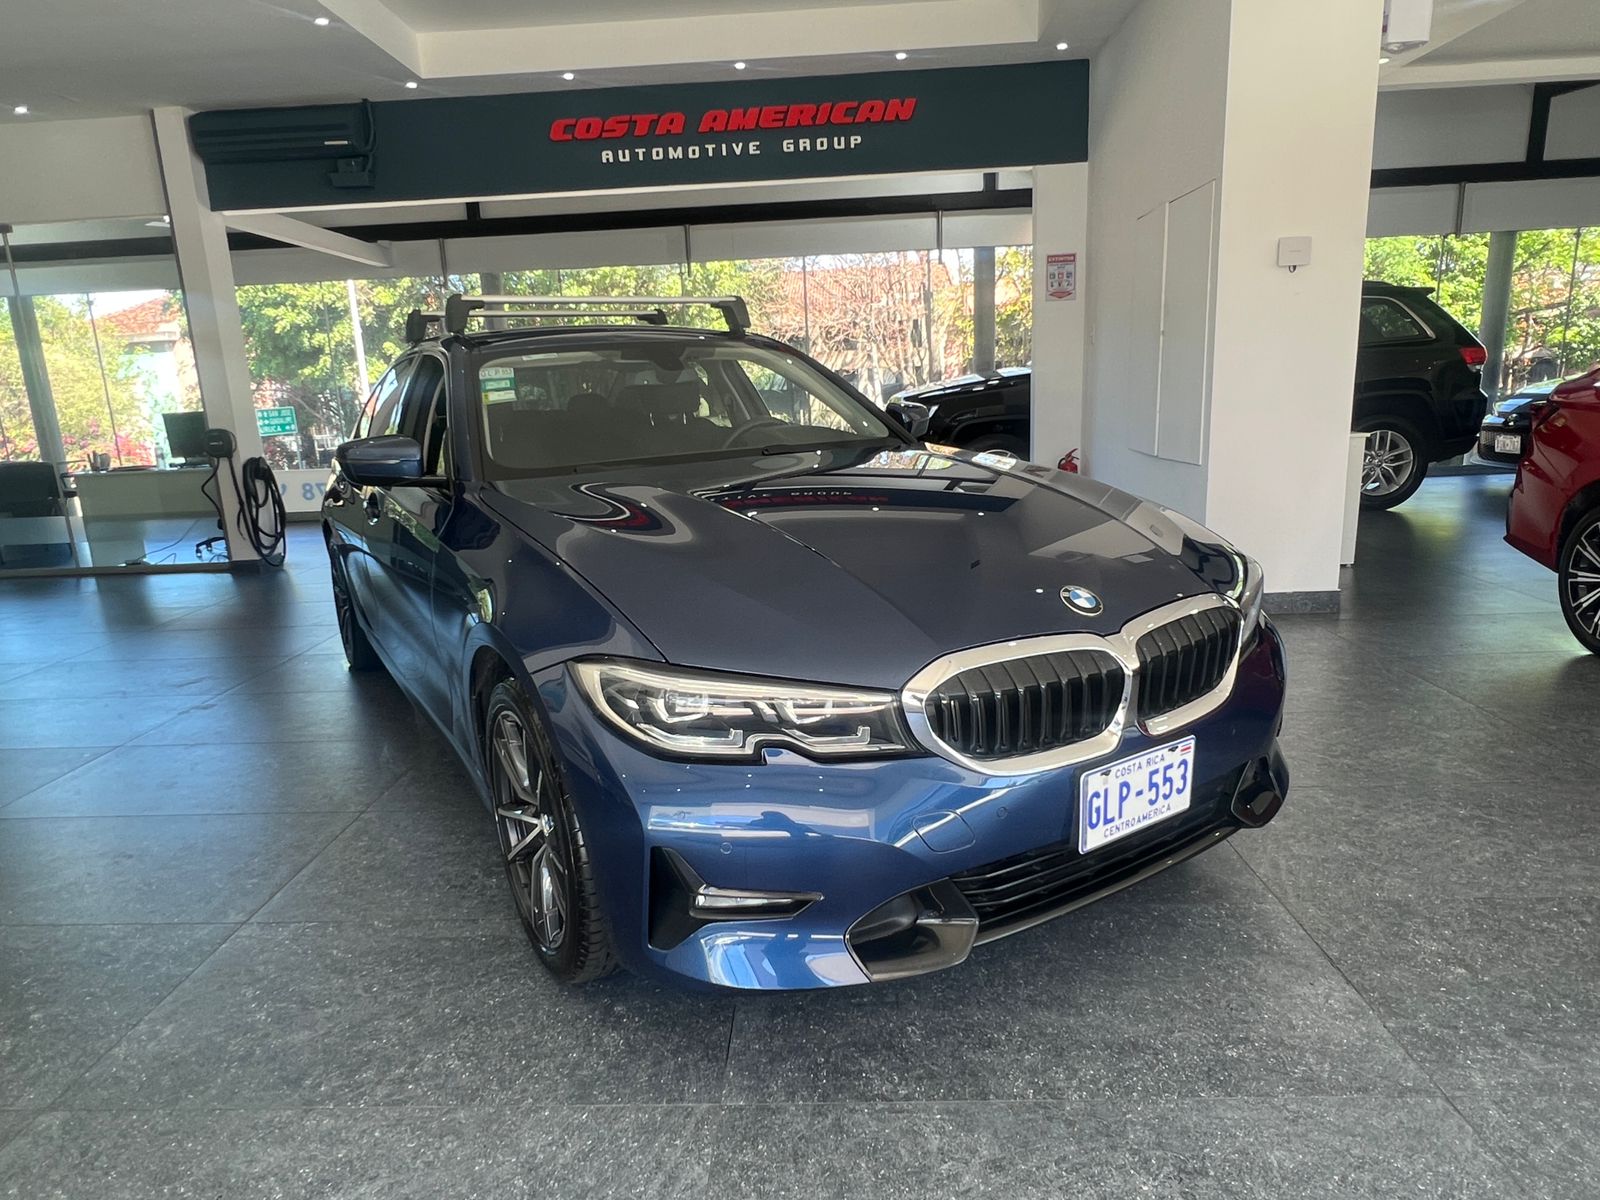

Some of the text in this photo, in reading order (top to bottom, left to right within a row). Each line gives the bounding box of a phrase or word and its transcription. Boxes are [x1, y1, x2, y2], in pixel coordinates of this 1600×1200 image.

[549, 98, 918, 142] COSTA AMERICAN
[601, 135, 863, 164] AUTOMOTIVE GROUP
[1115, 754, 1165, 779] COSTA RICA
[1088, 758, 1189, 830] GLP-553
[1103, 803, 1171, 838] CENTROAMERICA
